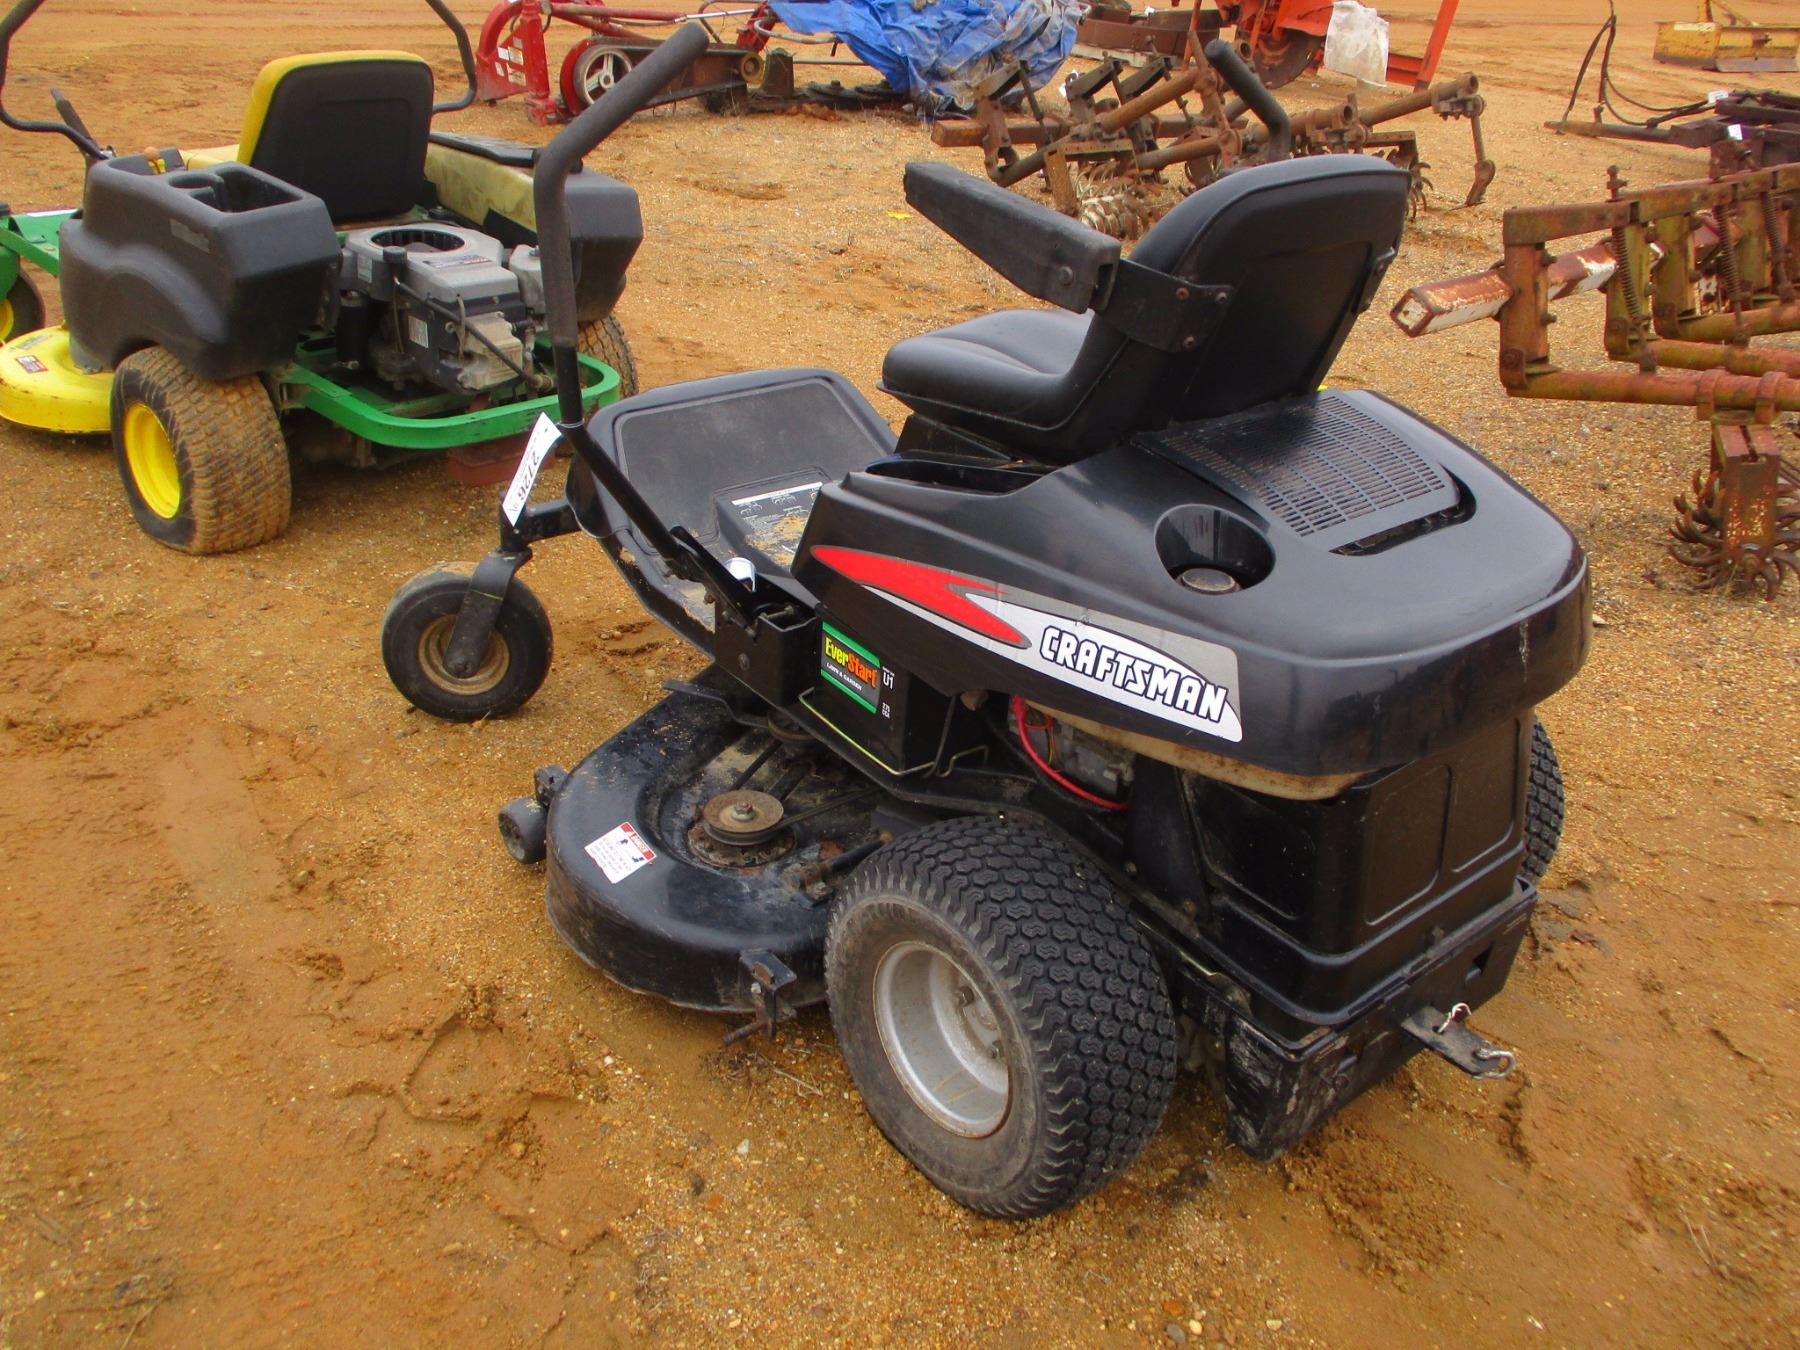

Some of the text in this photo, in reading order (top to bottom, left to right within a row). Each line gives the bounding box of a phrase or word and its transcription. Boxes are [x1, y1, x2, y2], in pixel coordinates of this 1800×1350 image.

[517, 450, 541, 501] 2726
[825, 636, 878, 690] EverStart
[1039, 625, 1229, 723] CRAFTSMAN
